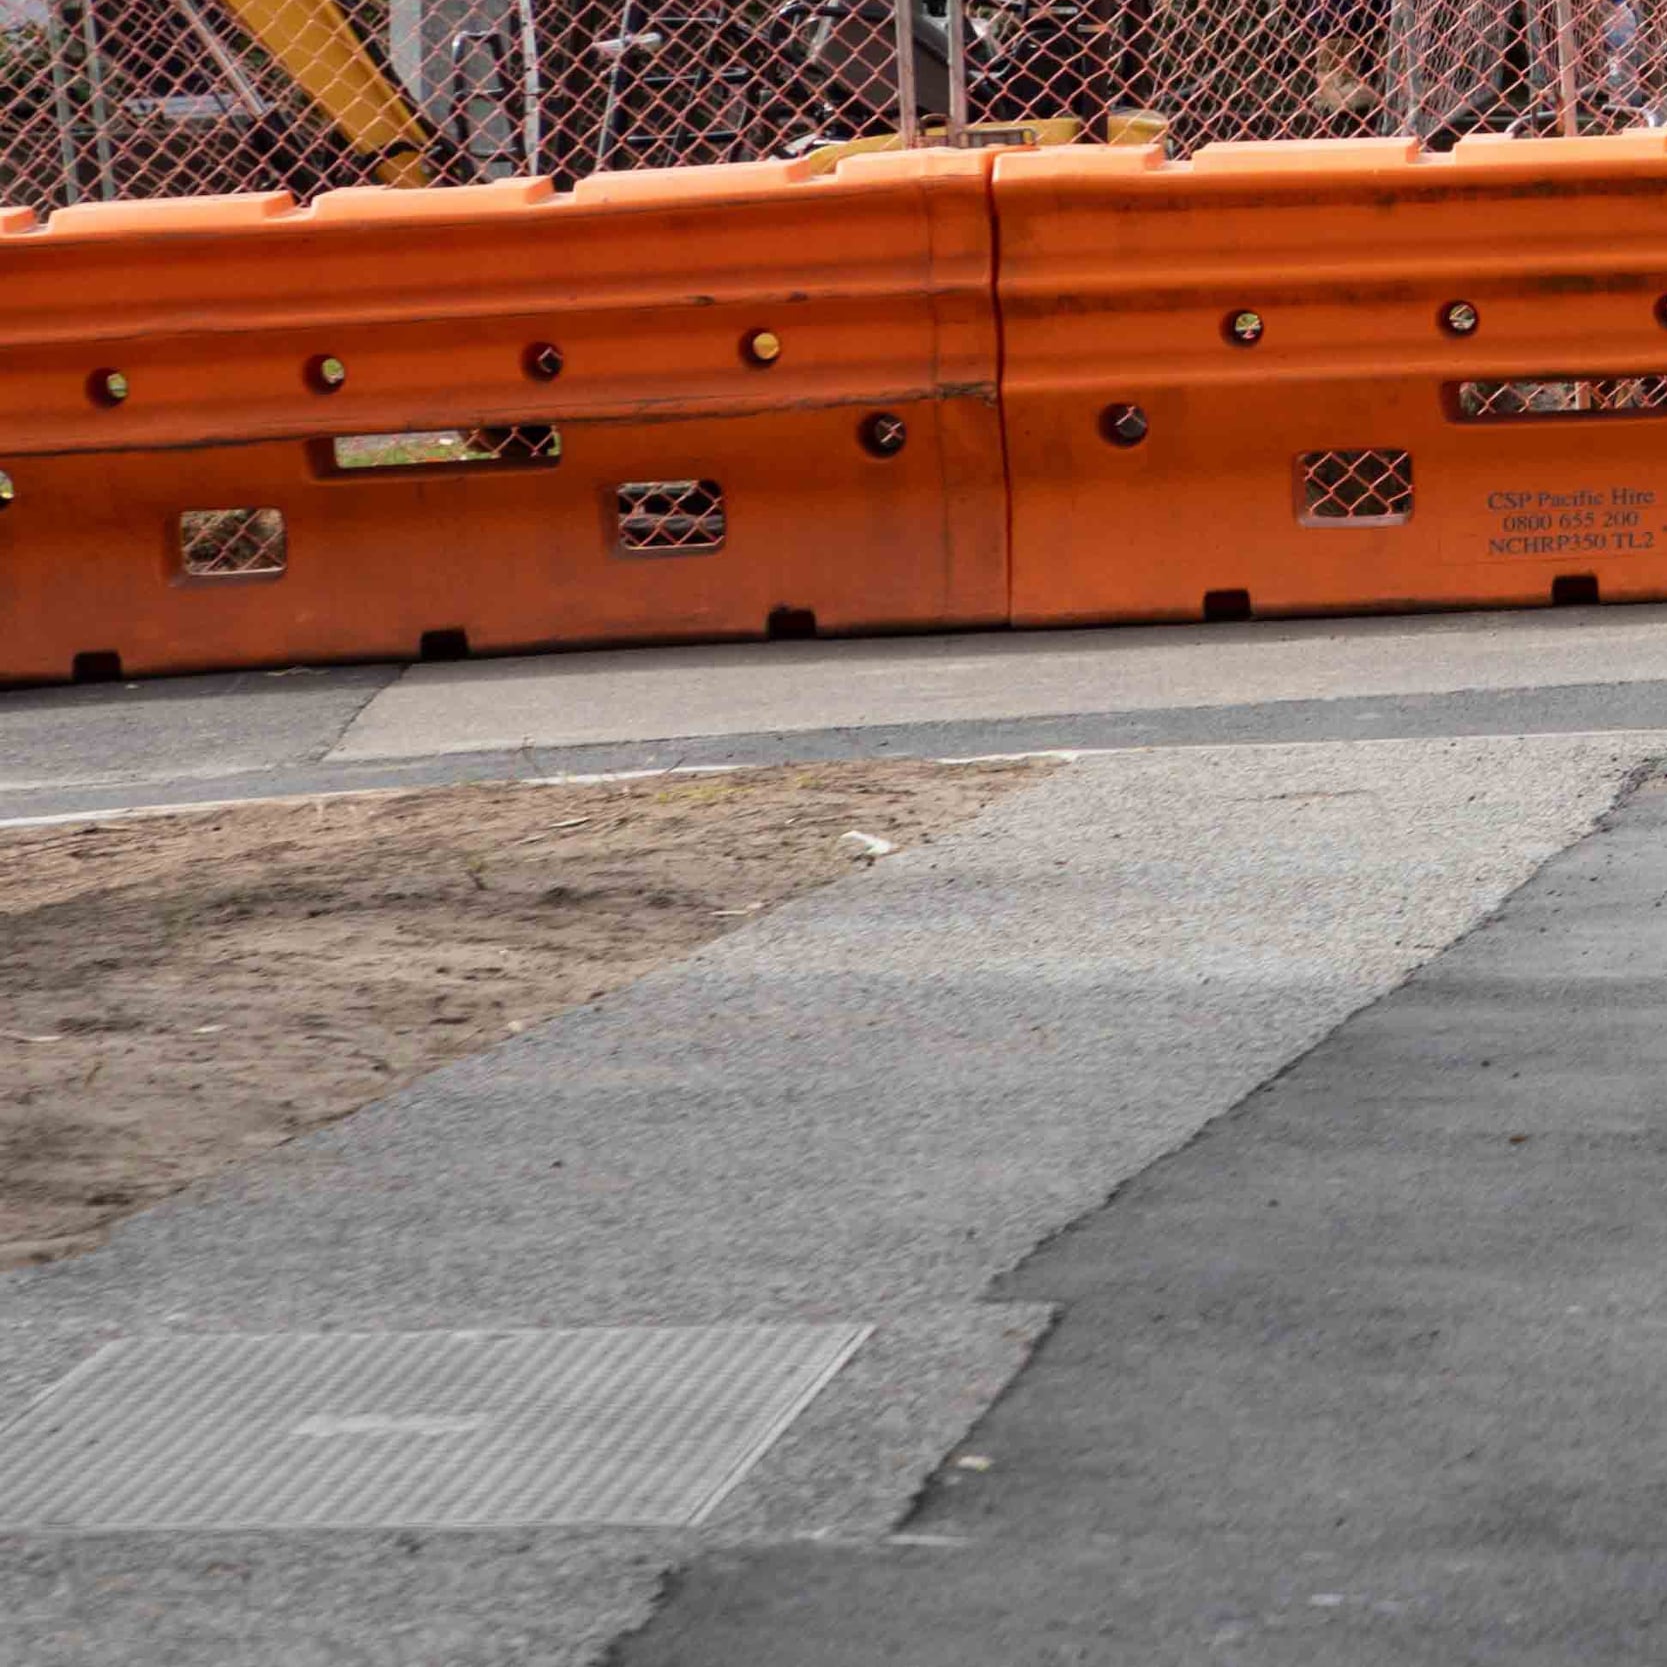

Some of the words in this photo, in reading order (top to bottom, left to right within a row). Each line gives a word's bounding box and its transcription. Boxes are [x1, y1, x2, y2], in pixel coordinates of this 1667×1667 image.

[1487, 491, 1532, 510] CSP
[1537, 489, 1603, 507] Pacific
[1611, 487, 1656, 506] Hire
[1502, 513, 1552, 532] 0800
[1559, 512, 1594, 528] 655
[1604, 510, 1639, 527] 200
[1489, 534, 1607, 553] NCHRP350
[1612, 531, 1655, 550] TL2
